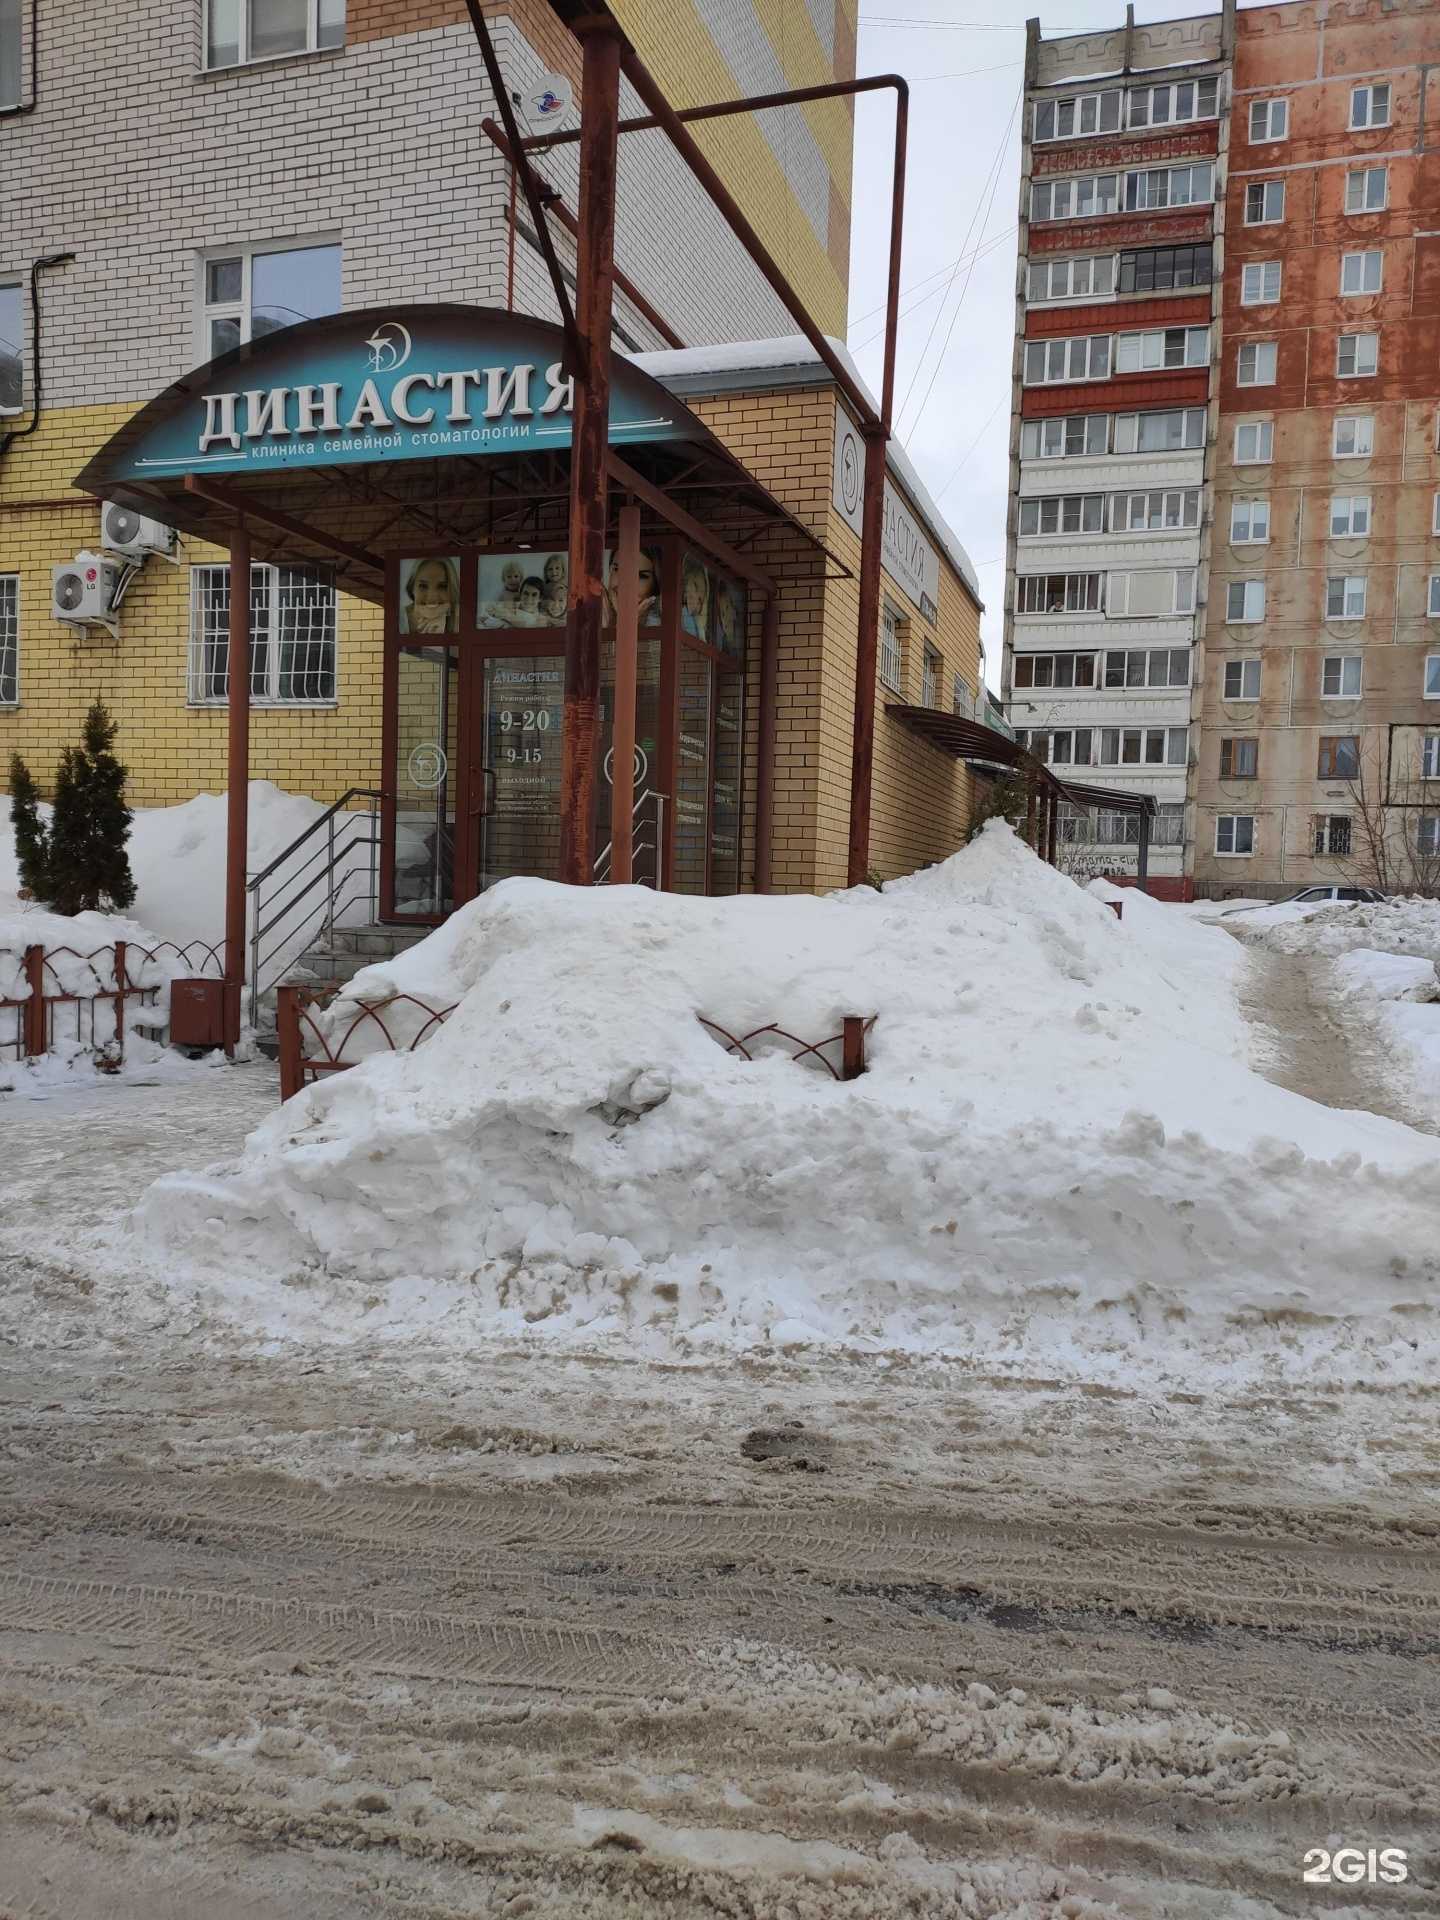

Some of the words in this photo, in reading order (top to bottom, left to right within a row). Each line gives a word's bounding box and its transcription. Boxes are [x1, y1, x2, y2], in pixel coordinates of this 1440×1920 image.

[199, 362, 575, 452] ДИНАСТИЯ
[251, 442, 315, 458] клиника
[323, 432, 402, 453] семейной
[411, 425, 530, 446] стоматологии
[500, 710, 550, 731] 9-20
[507, 748, 542, 763] 9-15
